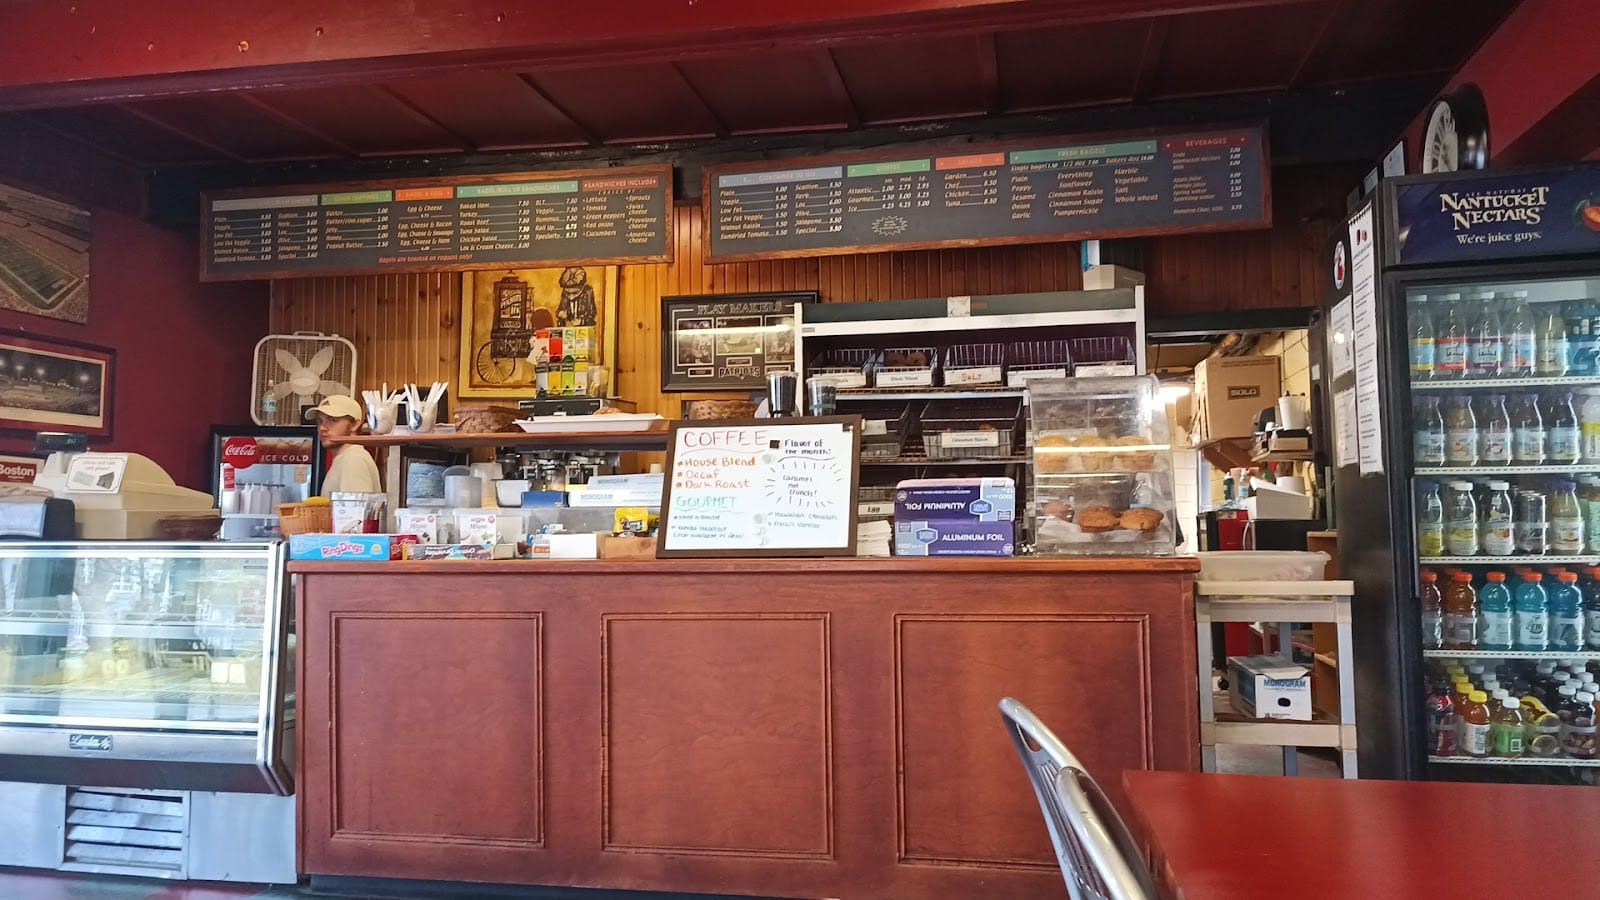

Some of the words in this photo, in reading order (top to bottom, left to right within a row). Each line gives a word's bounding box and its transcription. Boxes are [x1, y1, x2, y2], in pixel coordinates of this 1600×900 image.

[1185, 137, 1227, 147] BEVERAGES
[1057, 149, 1078, 158] FRESH
[1057, 170, 1094, 180] Everything
[587, 179, 626, 188] SANDWICHES
[628, 178, 653, 186] INCLUDE
[944, 190, 970, 198] Chicken
[1048, 190, 1082, 199] Cinnamon
[1048, 200, 1082, 208] Cinnamon
[1439, 186, 1549, 213] NANTUCKET
[1452, 207, 1541, 231] NECTARS
[410, 222, 429, 230] Cheese
[412, 238, 431, 246] Cheese
[1456, 233, 1487, 244] We're
[1487, 231, 1512, 245] juice
[476, 243, 494, 251] Cream
[696, 304, 728, 316] PLAY
[730, 301, 783, 314] MAKERS
[718, 367, 761, 379] PATRIOTS
[1230, 388, 1257, 396] SOLO
[684, 430, 768, 448] COFFEE
[784, 439, 811, 448] Flavor
[814, 439, 823, 448] of
[225, 444, 256, 456] Coca-Cola
[261, 454, 277, 462] ICE
[282, 454, 309, 462] COLD
[685, 457, 718, 467] House
[721, 456, 756, 467] Blend
[0, 464, 34, 476] Boston
[686, 469, 720, 479] Decaf
[714, 479, 751, 489] Roast
[676, 495, 737, 509] GOURMET
[923, 502, 966, 510] ALUMINUM
[1263, 679, 1306, 688] MONOGRAM
